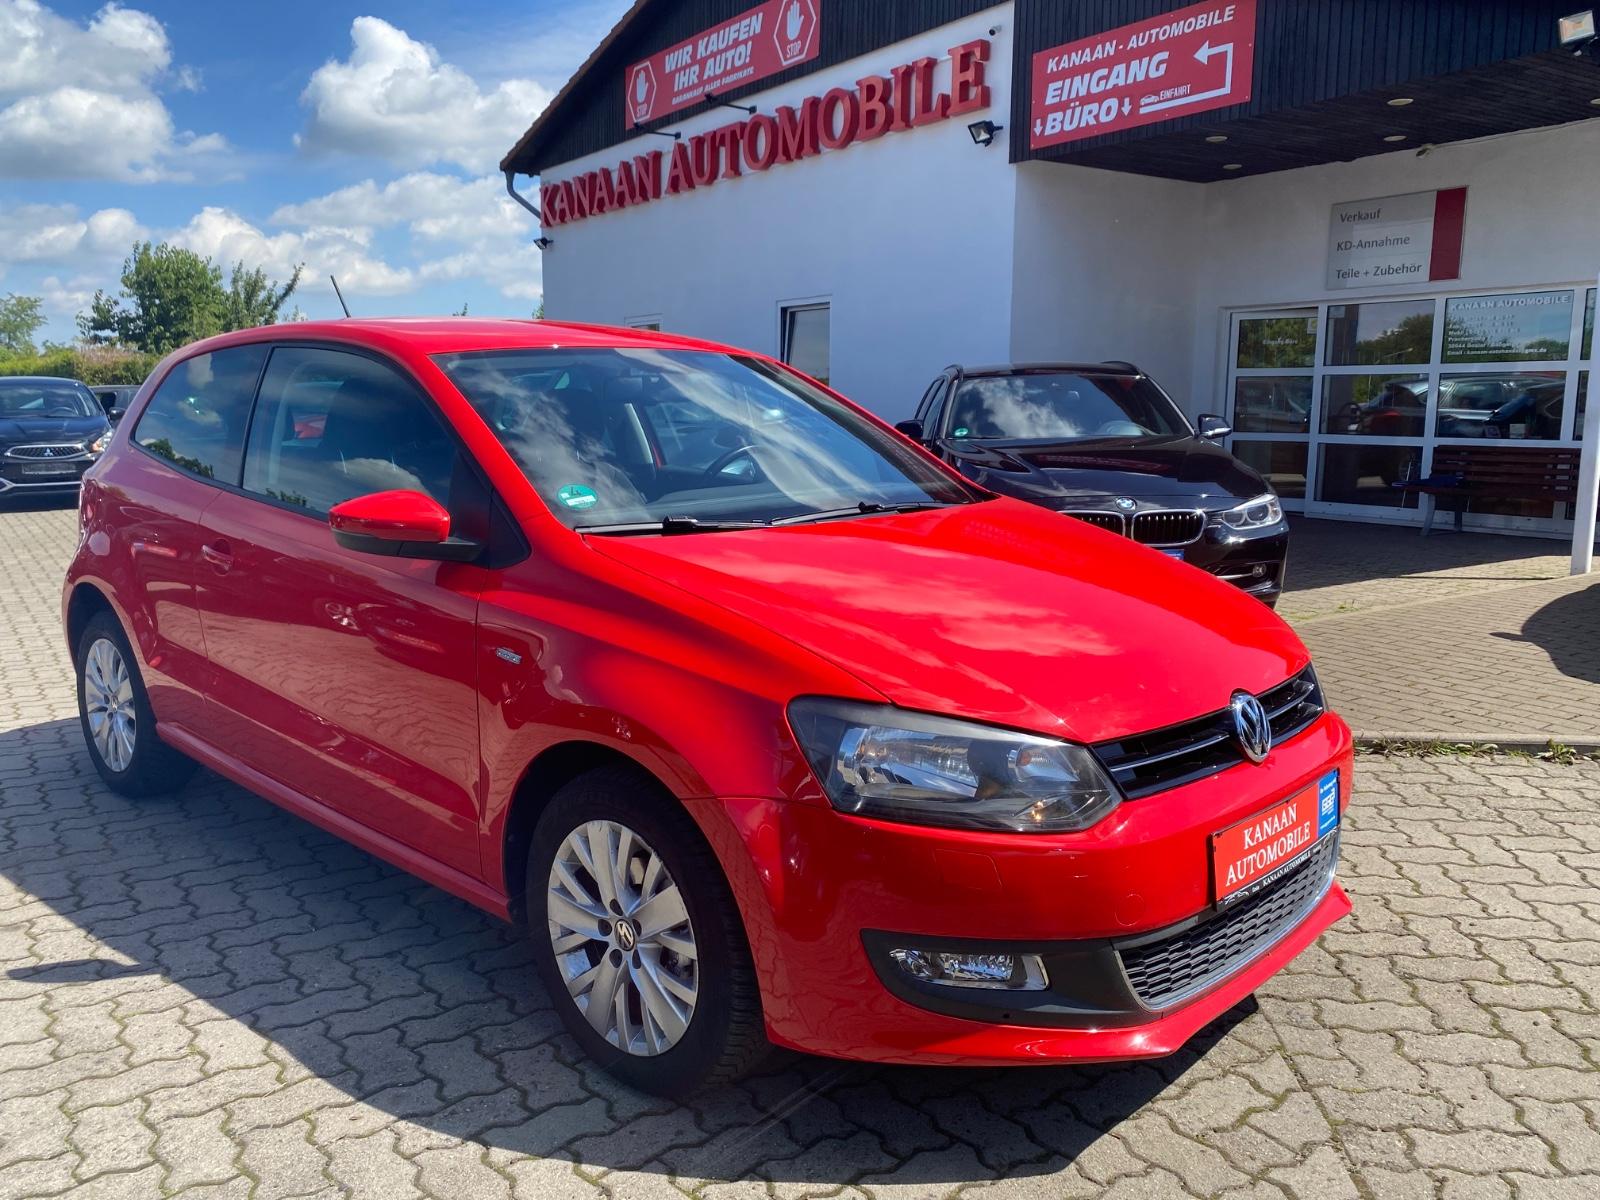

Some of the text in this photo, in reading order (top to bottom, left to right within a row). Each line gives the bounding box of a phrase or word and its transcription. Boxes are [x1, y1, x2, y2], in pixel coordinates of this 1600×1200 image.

[664, 12, 763, 74] WIR KAUFEN
[786, 41, 802, 58] STOP
[1047, 40, 1116, 73] KANAAN
[1127, 5, 1236, 49] AUTOMOBILE
[674, 41, 753, 92] IHR AUTO!
[1044, 51, 1170, 105] EINGANG
[637, 103, 648, 118] STOP
[1160, 84, 1191, 100] EINFAHRT
[540, 39, 991, 228] KANAAN AUTOMOBILE
[1045, 98, 1119, 136] BÜRO
[1340, 208, 1381, 223] Verkauf
[1336, 236, 1410, 252] KD-Annahme
[1336, 268, 1360, 279] Teile
[1373, 264, 1422, 276] Zubehör
[1451, 295, 1570, 312] KANAAN AUTOMOBILE
[1243, 803, 1297, 850] KANAAN
[1225, 821, 1311, 887] AUTOMOBILE
